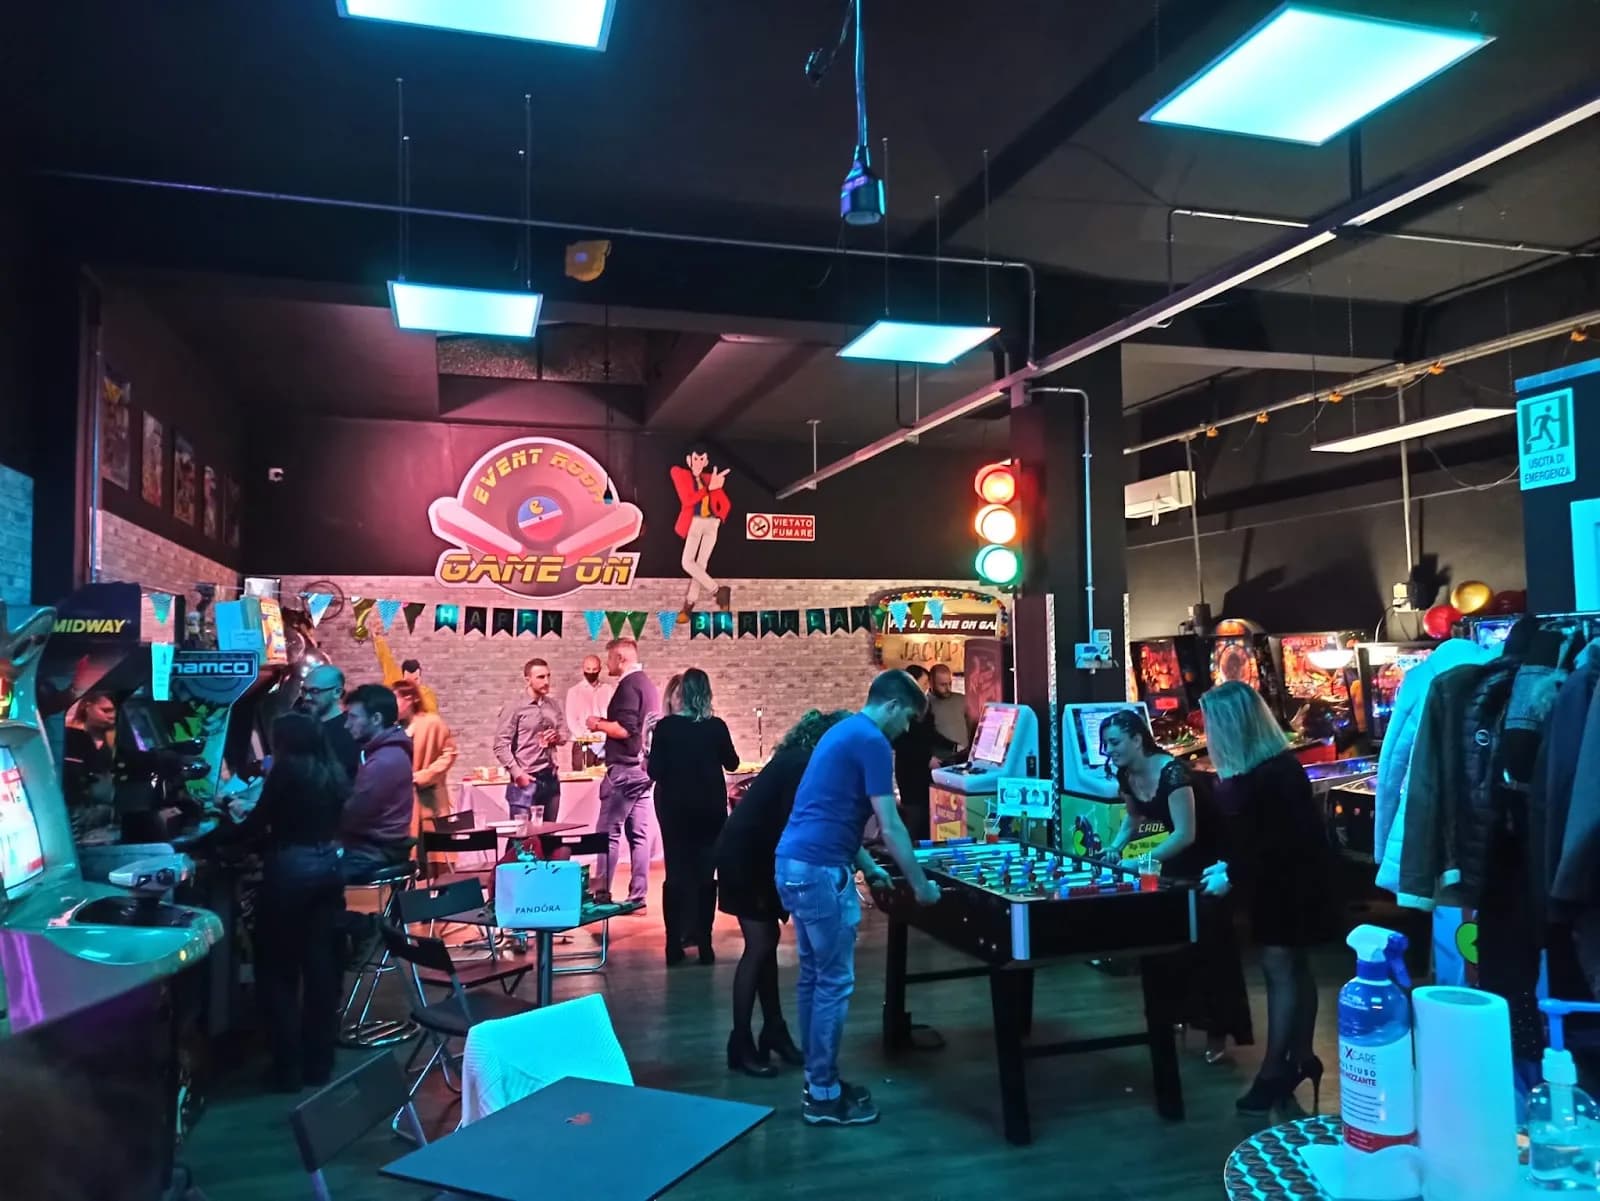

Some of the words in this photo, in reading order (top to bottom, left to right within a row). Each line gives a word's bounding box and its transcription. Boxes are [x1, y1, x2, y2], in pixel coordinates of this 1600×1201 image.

[1528, 456, 1555, 469] USCITA
[472, 448, 544, 505] EVENT
[773, 518, 813, 528] VIETATO
[773, 528, 813, 538] FUMARE
[440, 553, 564, 584] GAME
[575, 556, 634, 586] ON
[439, 606, 558, 629] HAPPY
[52, 619, 126, 634] MIDWAY
[978, 620, 998, 631] GA
[171, 661, 250, 674] namco
